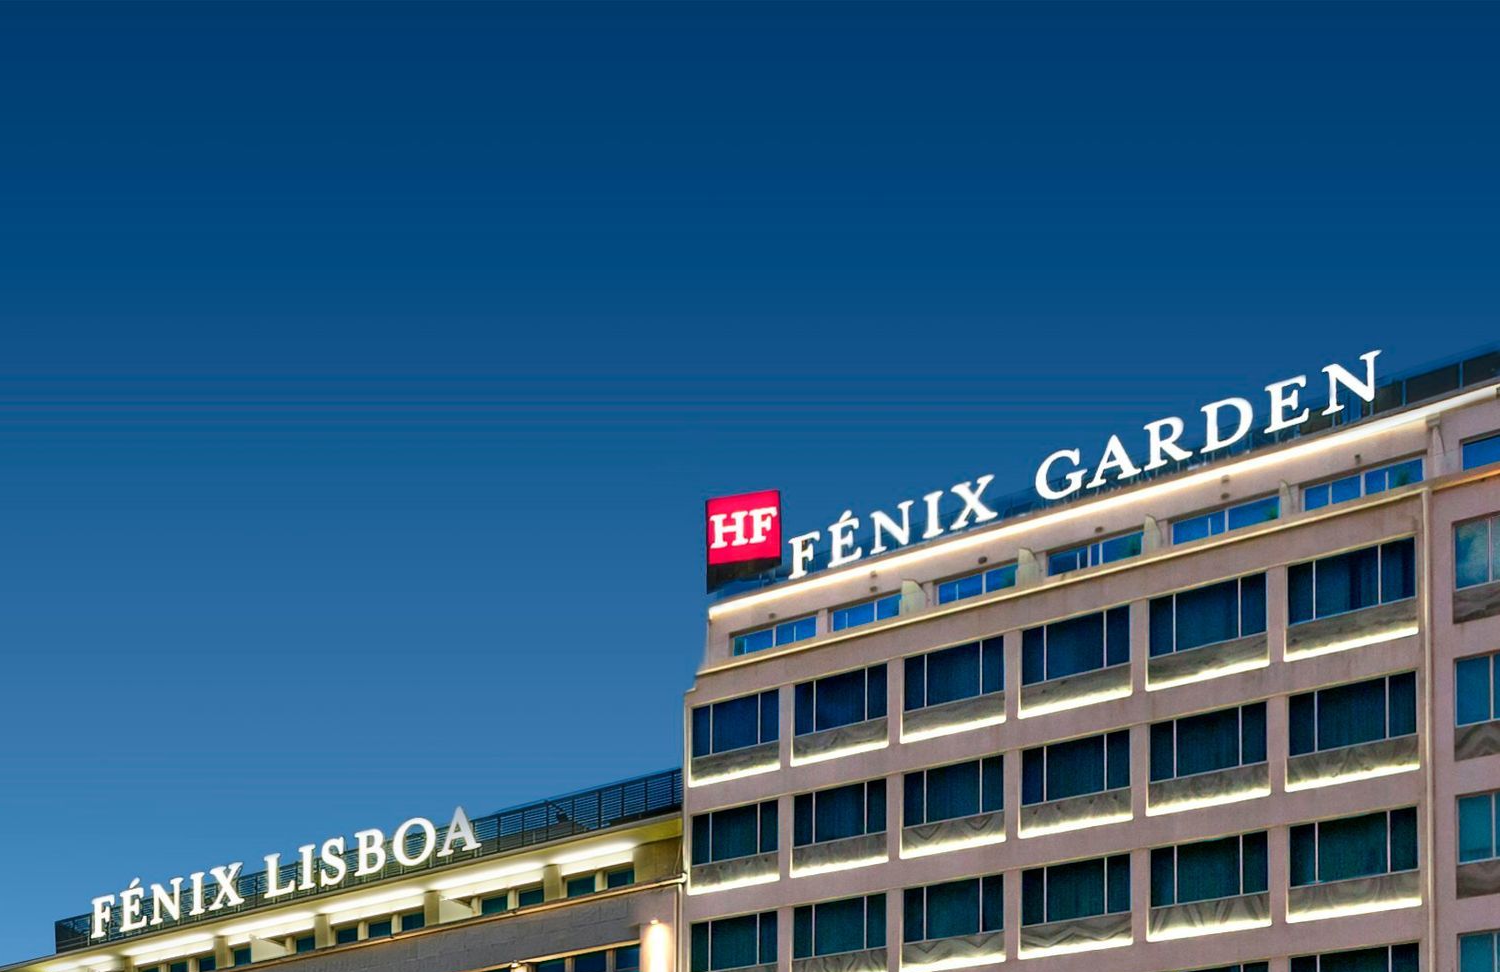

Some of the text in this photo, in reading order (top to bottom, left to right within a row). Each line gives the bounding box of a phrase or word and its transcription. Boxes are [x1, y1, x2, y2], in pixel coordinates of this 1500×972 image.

[709, 349, 1383, 581] HF FÉNIX GARDEN
[90, 806, 483, 939] FÉNIX LISBOA
